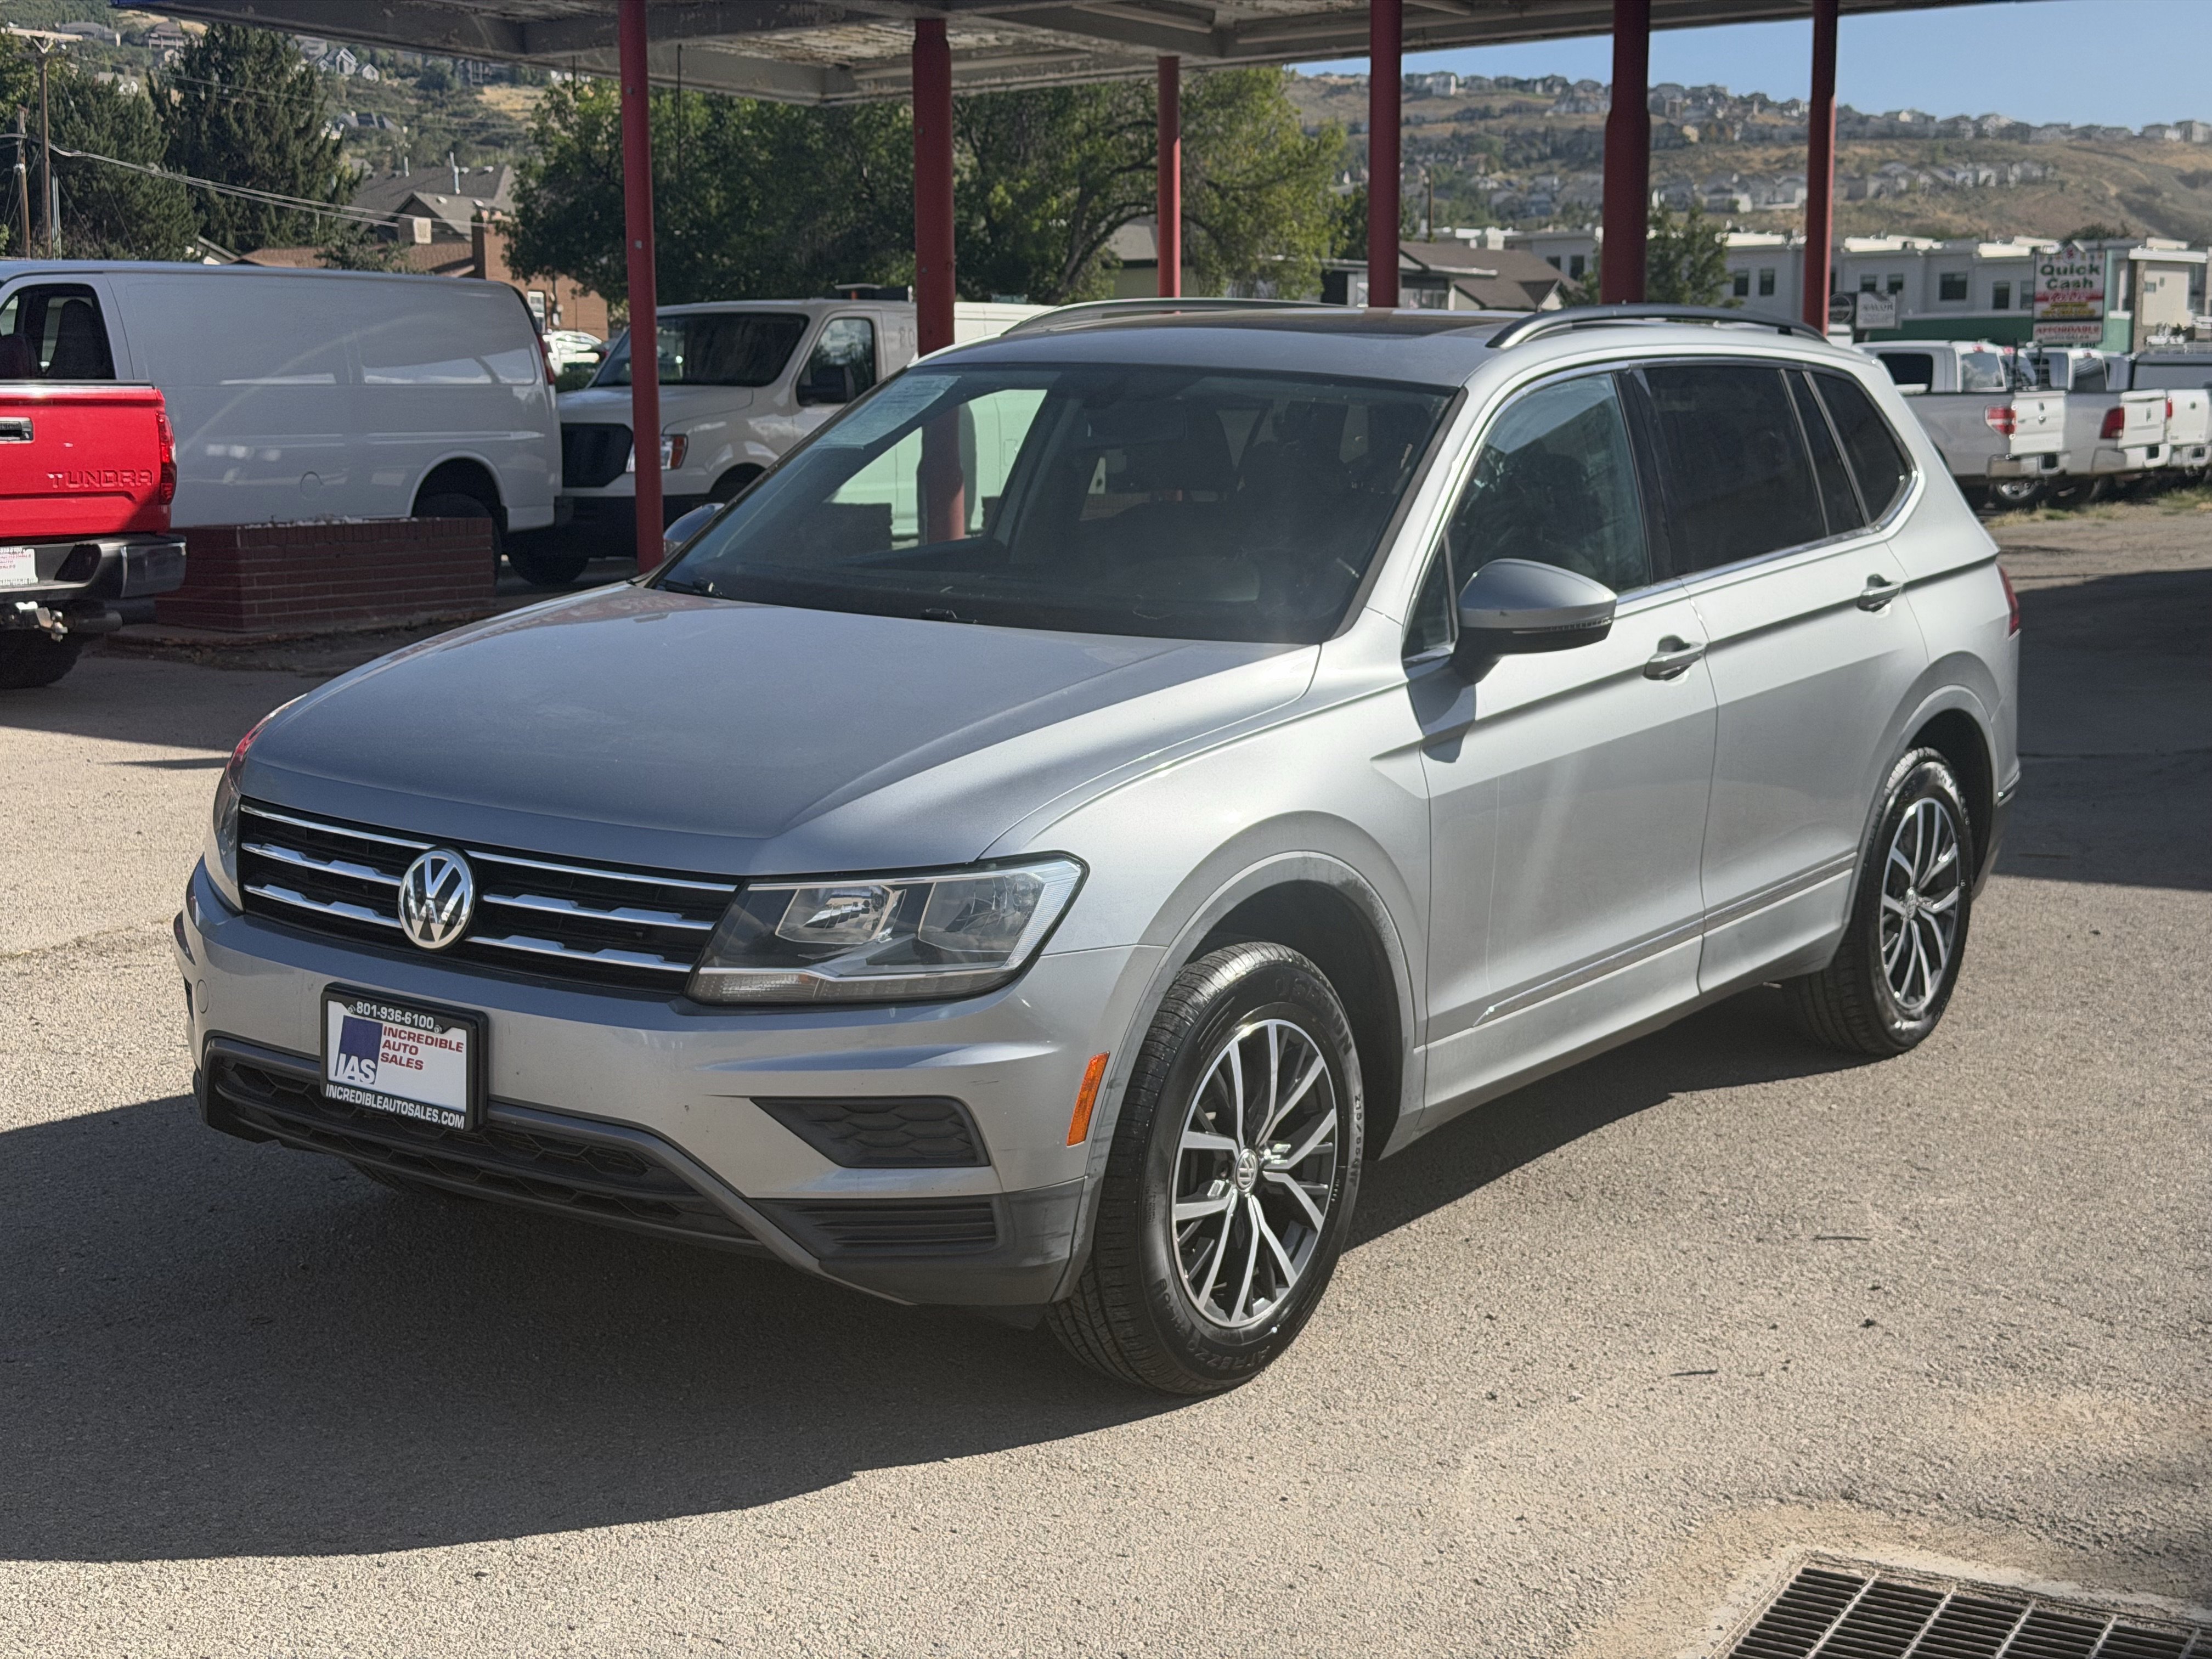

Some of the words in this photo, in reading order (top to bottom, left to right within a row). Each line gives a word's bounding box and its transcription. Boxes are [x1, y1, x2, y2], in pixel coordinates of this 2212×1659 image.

[2040, 263, 2101, 276] Quick
[2046, 277, 2094, 290] Cash
[46, 470, 153, 489] TUNDRA
[356, 1001, 435, 1030] 801-936-6100
[382, 1039, 419, 1056] AUTO
[383, 1025, 465, 1053] INCREDIBLE
[380, 1052, 424, 1070] SALES
[325, 1084, 465, 1130] INCREDIBLEAUTOSALES.COM
